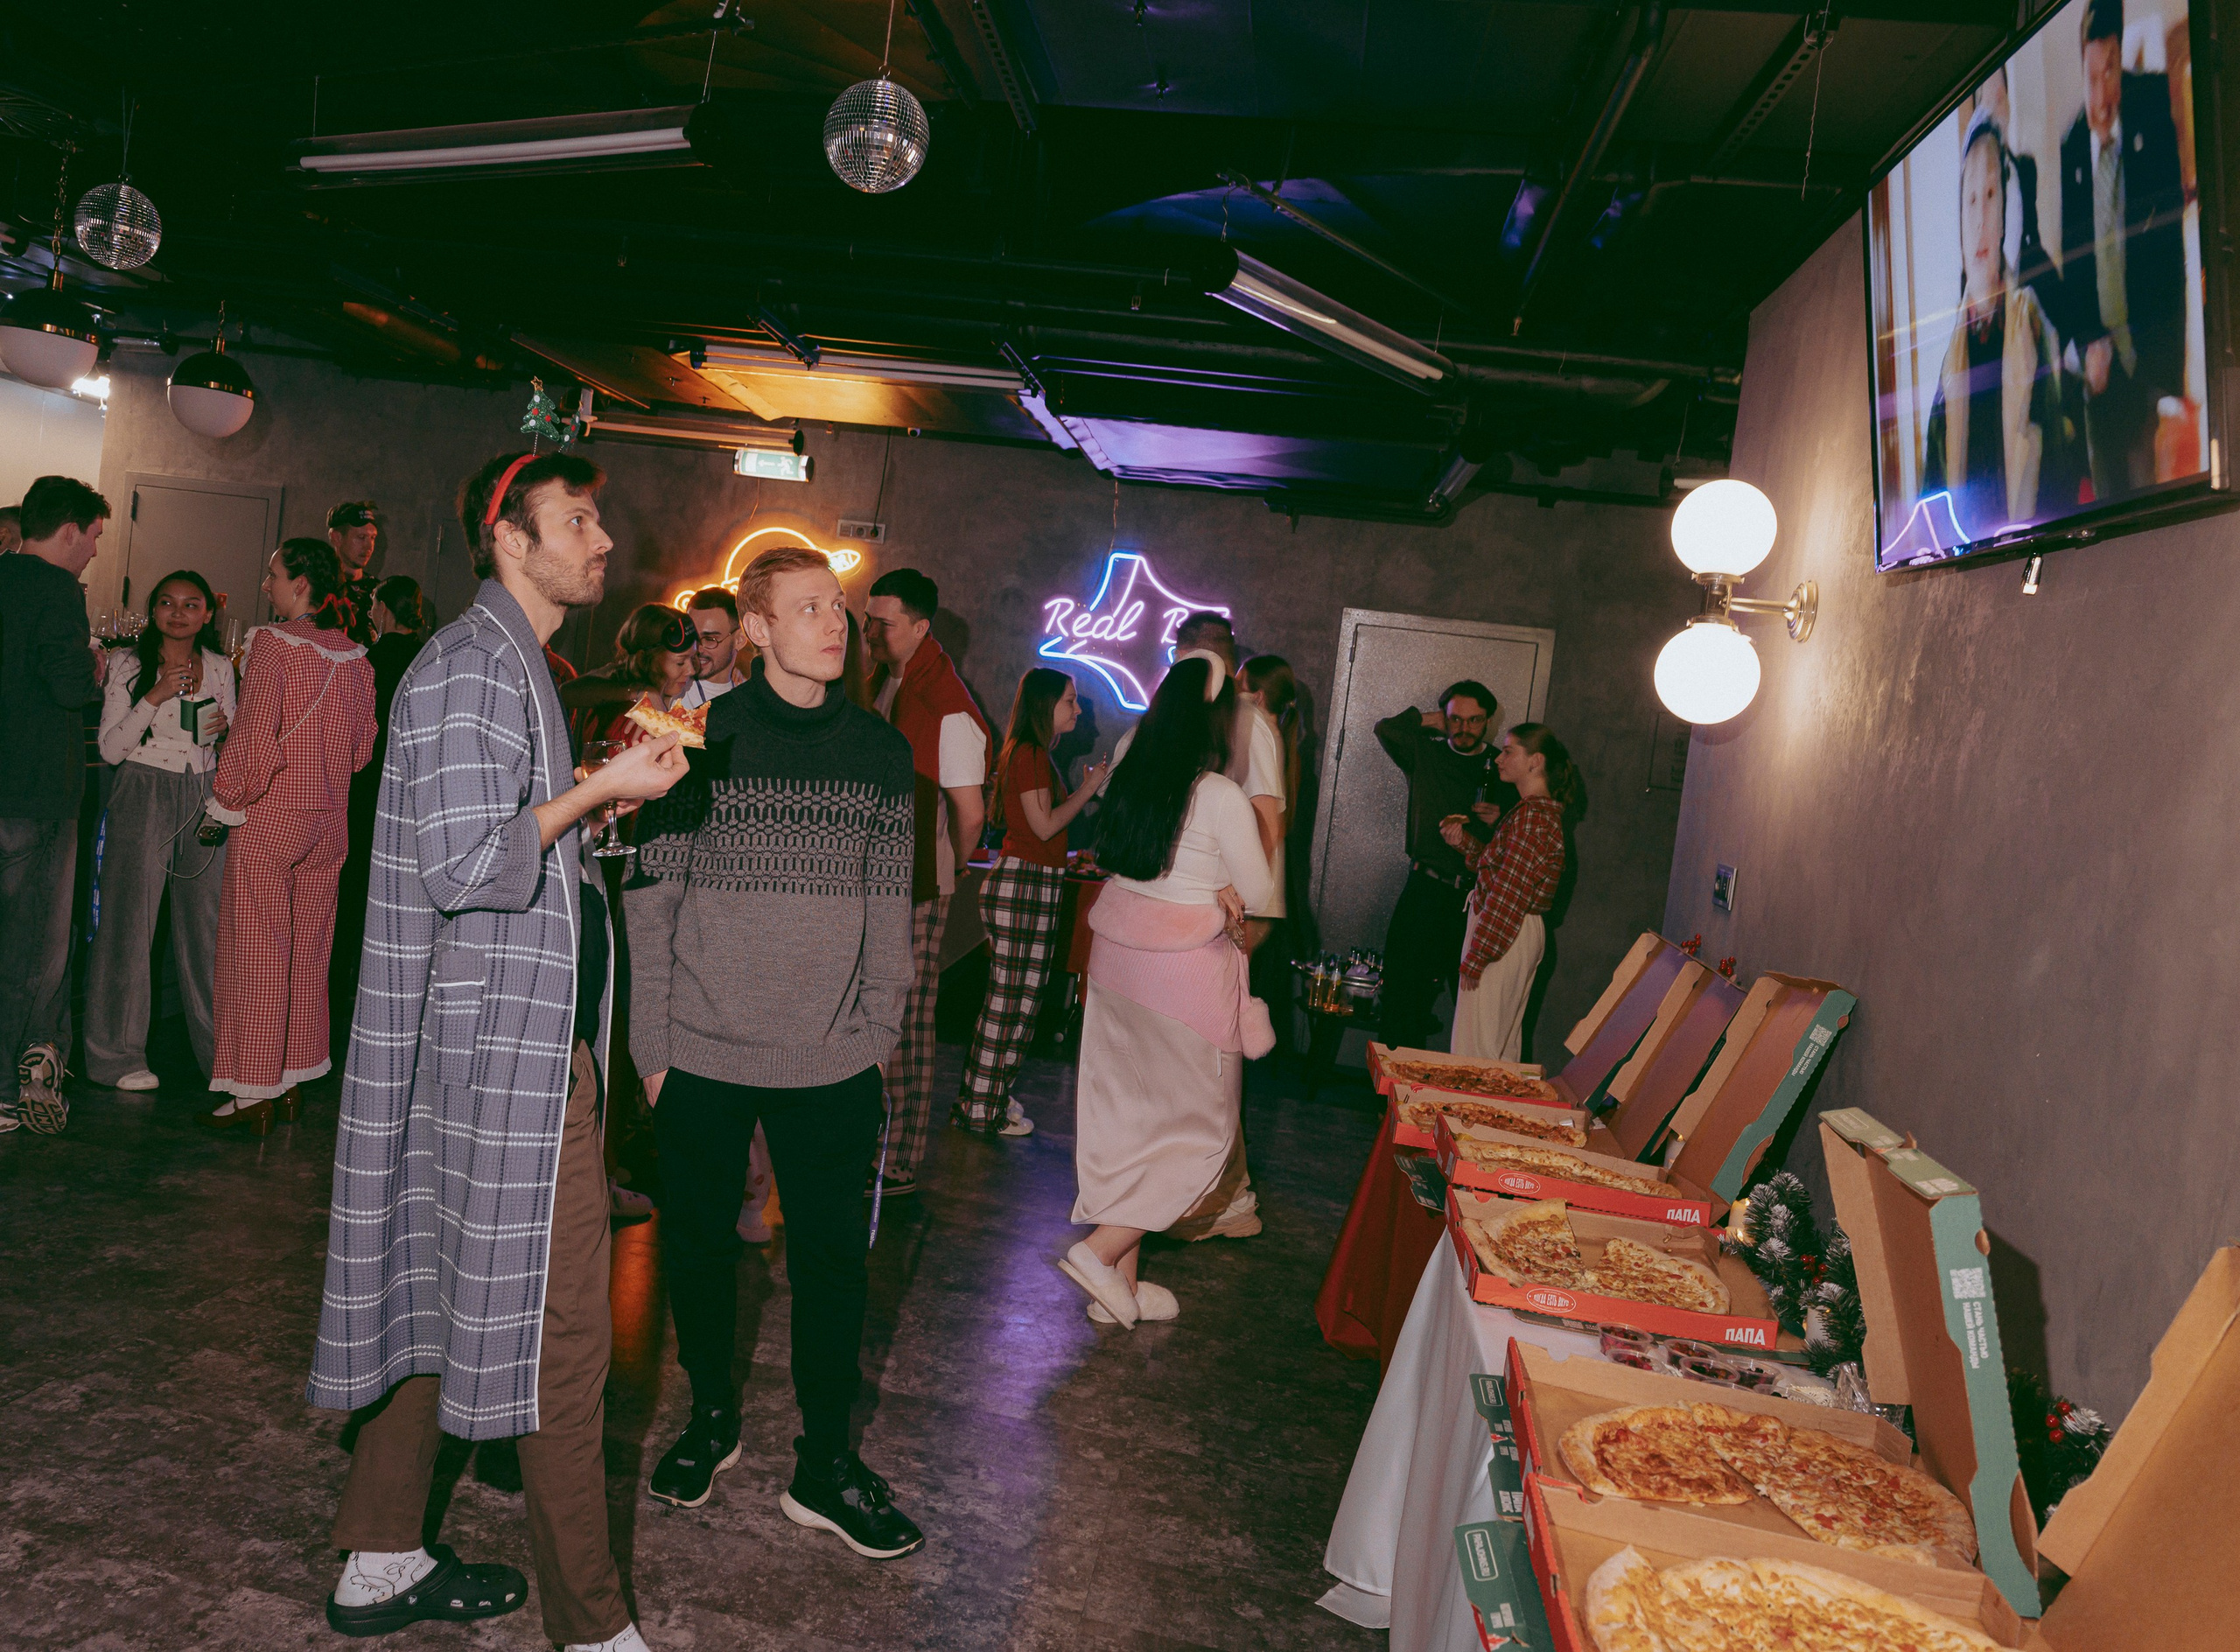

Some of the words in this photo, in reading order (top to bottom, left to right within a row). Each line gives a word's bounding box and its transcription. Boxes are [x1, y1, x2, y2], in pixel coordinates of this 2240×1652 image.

[1044, 598, 1144, 641] Real
[1666, 1208, 1701, 1224] ПАПА
[1973, 1301, 1984, 1326] СТАНЬ
[1725, 1327, 1766, 1346] ПАПА
[1978, 1327, 1989, 1359] ЧАСТЬЮ
